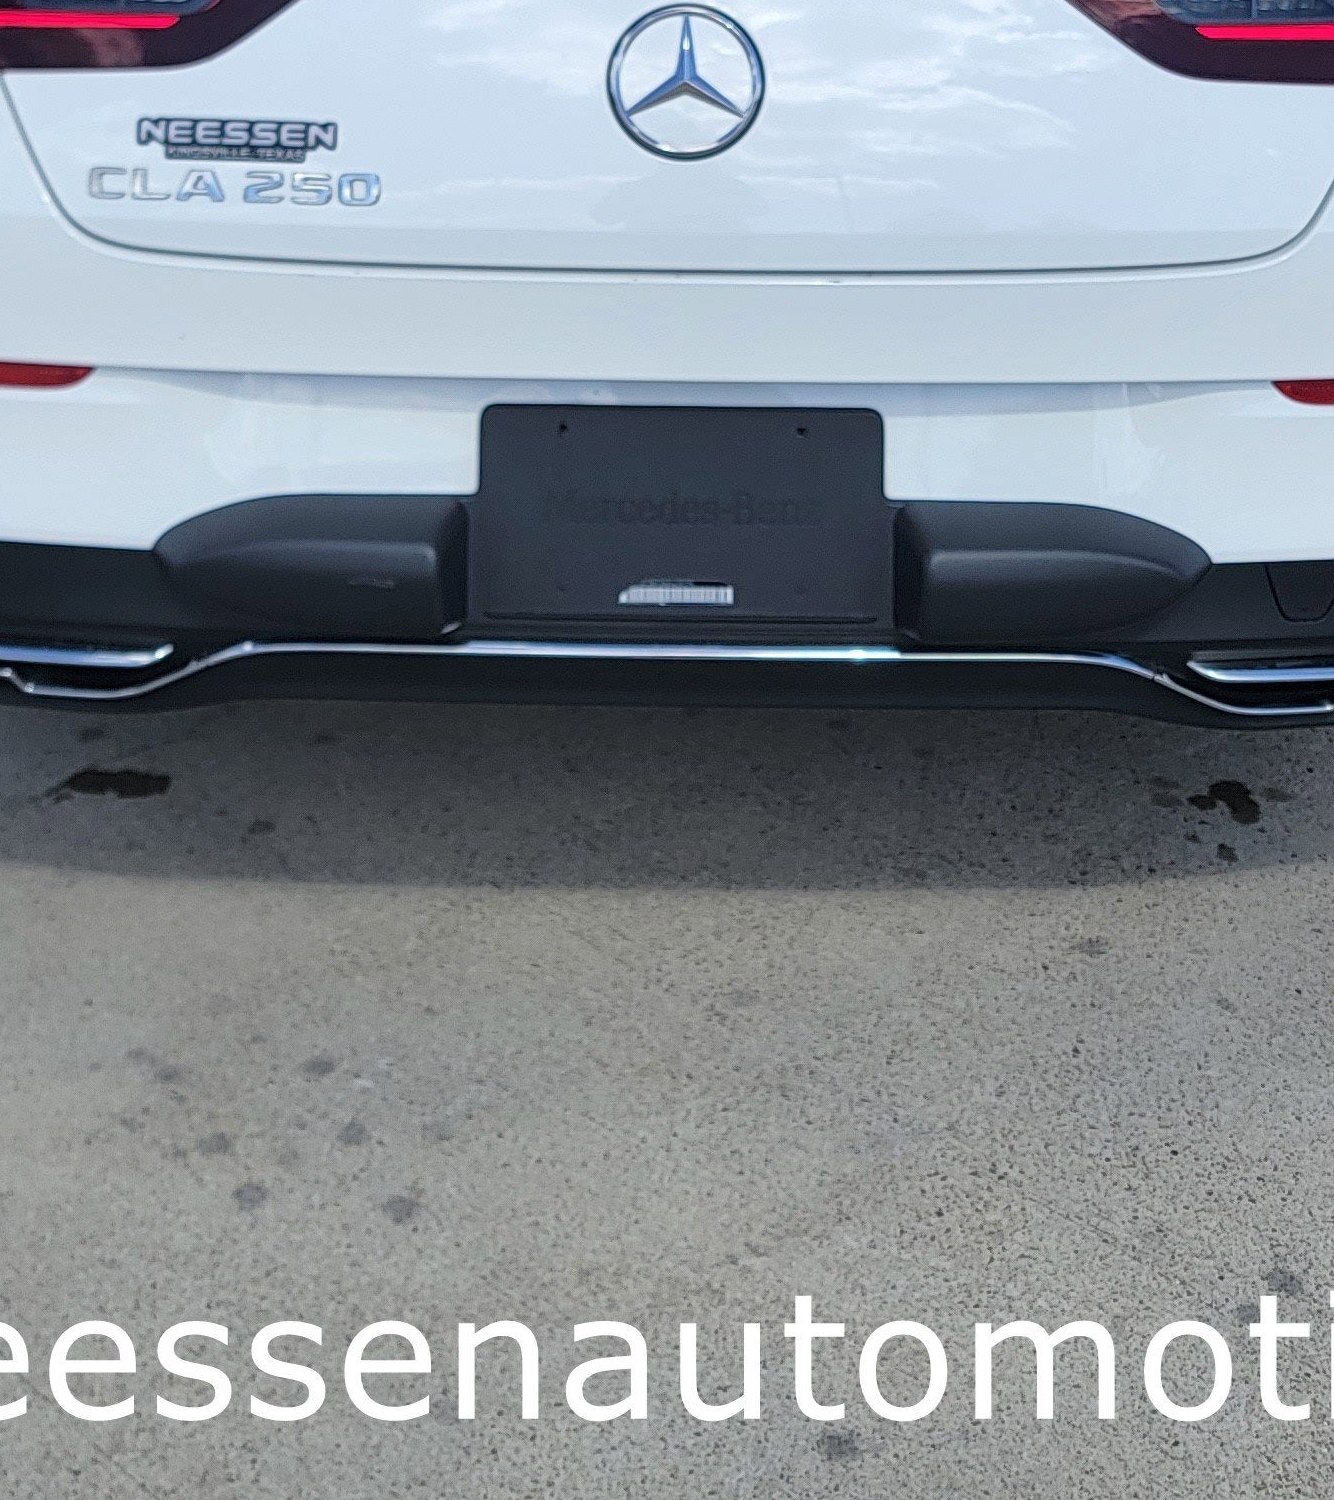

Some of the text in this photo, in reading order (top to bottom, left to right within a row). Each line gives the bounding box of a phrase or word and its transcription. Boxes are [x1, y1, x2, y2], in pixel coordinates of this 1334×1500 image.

[137, 118, 337, 150] NEESSEN
[88, 167, 382, 207] CLA 250
[541, 488, 824, 526] Mercedes-Benz
